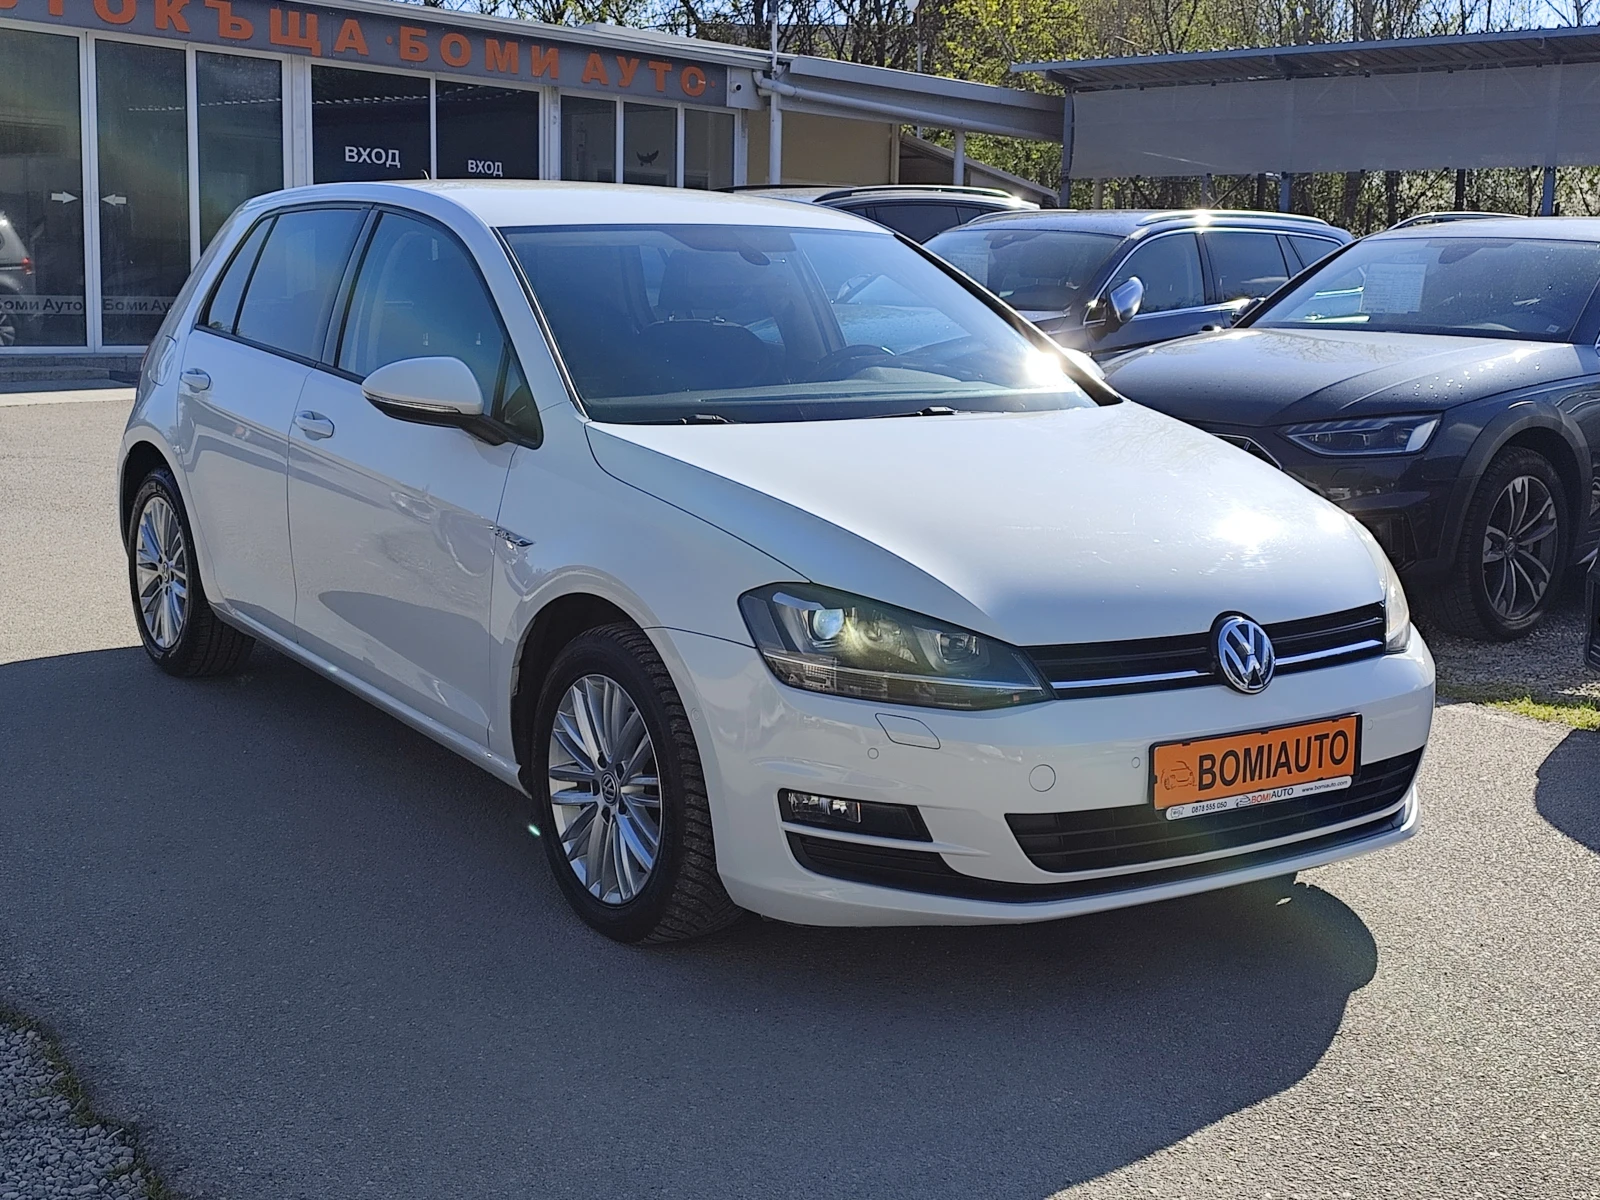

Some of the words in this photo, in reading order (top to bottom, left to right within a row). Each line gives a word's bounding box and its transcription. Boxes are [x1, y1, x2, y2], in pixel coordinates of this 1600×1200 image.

[0, 0, 369, 56] ОКЪЩА
[399, 26, 559, 79] БОМИ
[581, 52, 707, 97] АУТО
[345, 146, 401, 168] ВХОД
[467, 160, 503, 177] ВХОД
[43, 299, 83, 313] Ауто
[103, 298, 148, 311] Боми
[150, 299, 174, 314] Ау
[1198, 729, 1349, 791] BOMIAUTO
[1301, 780, 1348, 792] www.bomiauto.com
[1251, 787, 1294, 803] BOMIAUTO
